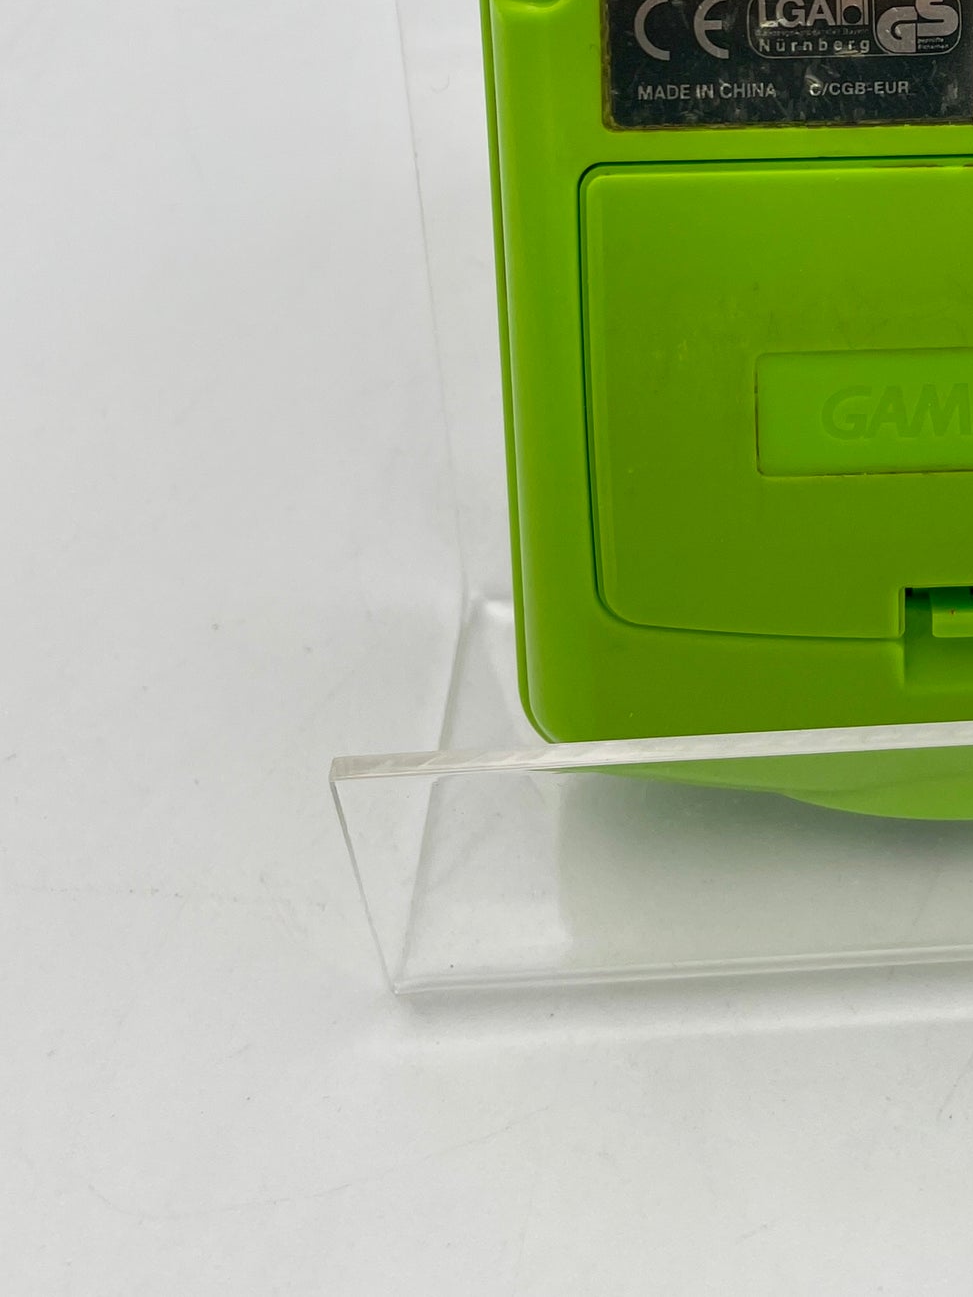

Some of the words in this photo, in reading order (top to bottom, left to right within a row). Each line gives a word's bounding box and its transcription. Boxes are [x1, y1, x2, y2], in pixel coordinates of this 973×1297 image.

[759, 38, 870, 54] Nürnberg
[638, 84, 690, 100] MADE
[696, 84, 713, 99] IN
[720, 83, 777, 98] CHINA
[809, 81, 909, 96] C/CGB-EUR
